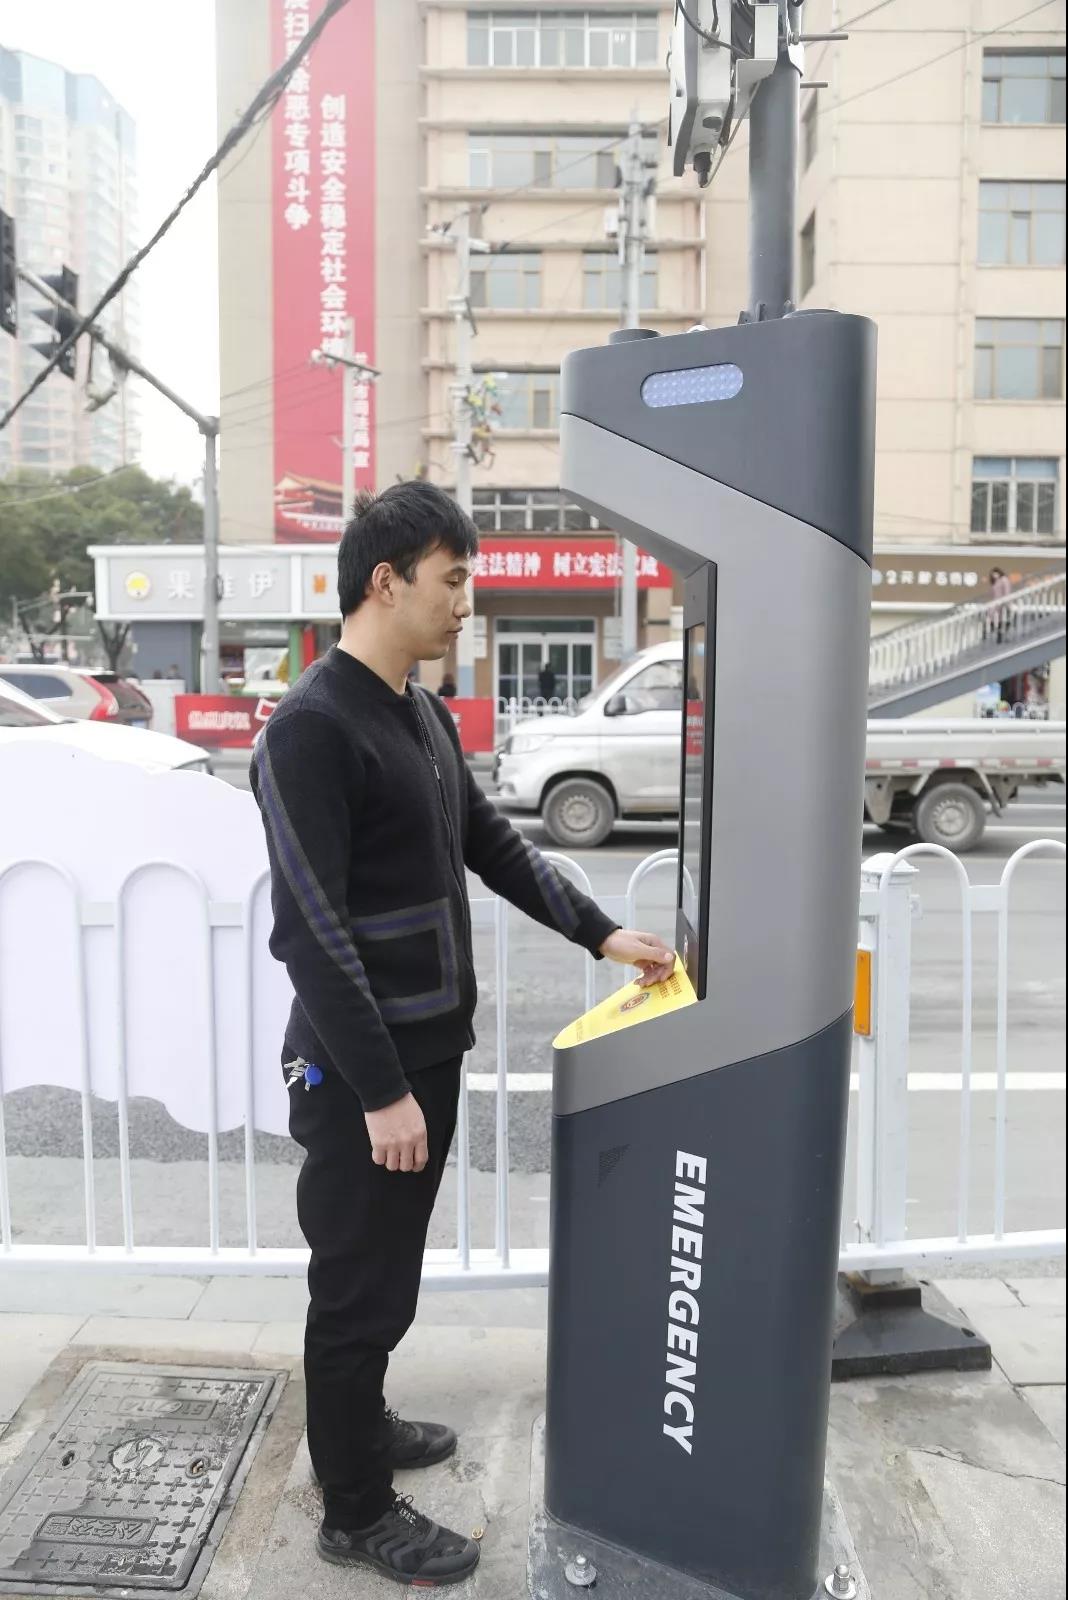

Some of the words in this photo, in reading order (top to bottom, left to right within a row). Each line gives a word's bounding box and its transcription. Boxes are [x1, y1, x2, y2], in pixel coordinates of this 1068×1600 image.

[553, 552, 659, 577] 树立宪法威
[663, 1149, 708, 1456] EMERGENCY
